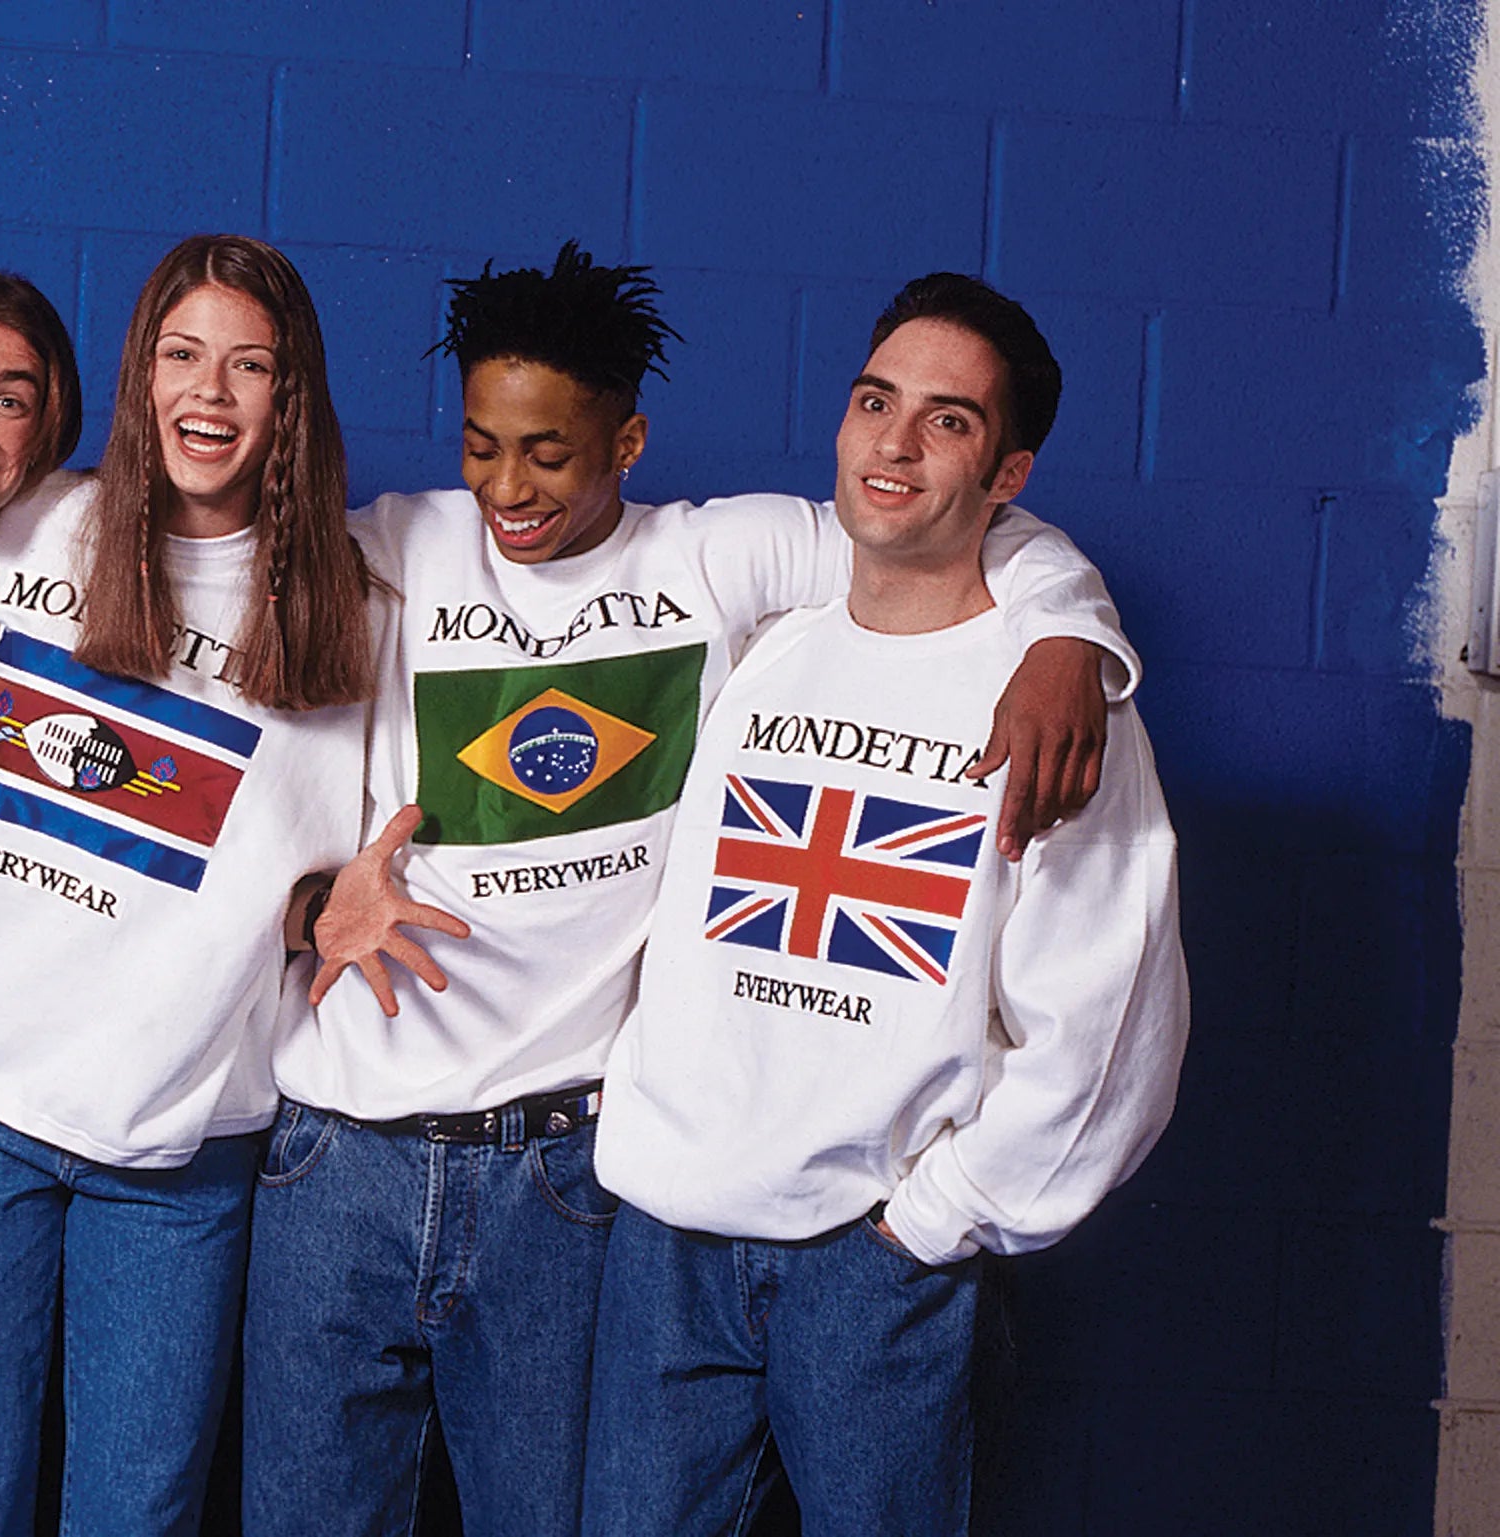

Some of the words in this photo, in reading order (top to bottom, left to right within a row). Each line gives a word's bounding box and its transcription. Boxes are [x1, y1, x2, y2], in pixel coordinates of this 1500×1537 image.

[428, 591, 693, 658] MONDETTA
[741, 713, 989, 789] MONDETTA
[472, 845, 650, 898] EVERYWEAR
[733, 971, 872, 1025] EVERYWEAR
